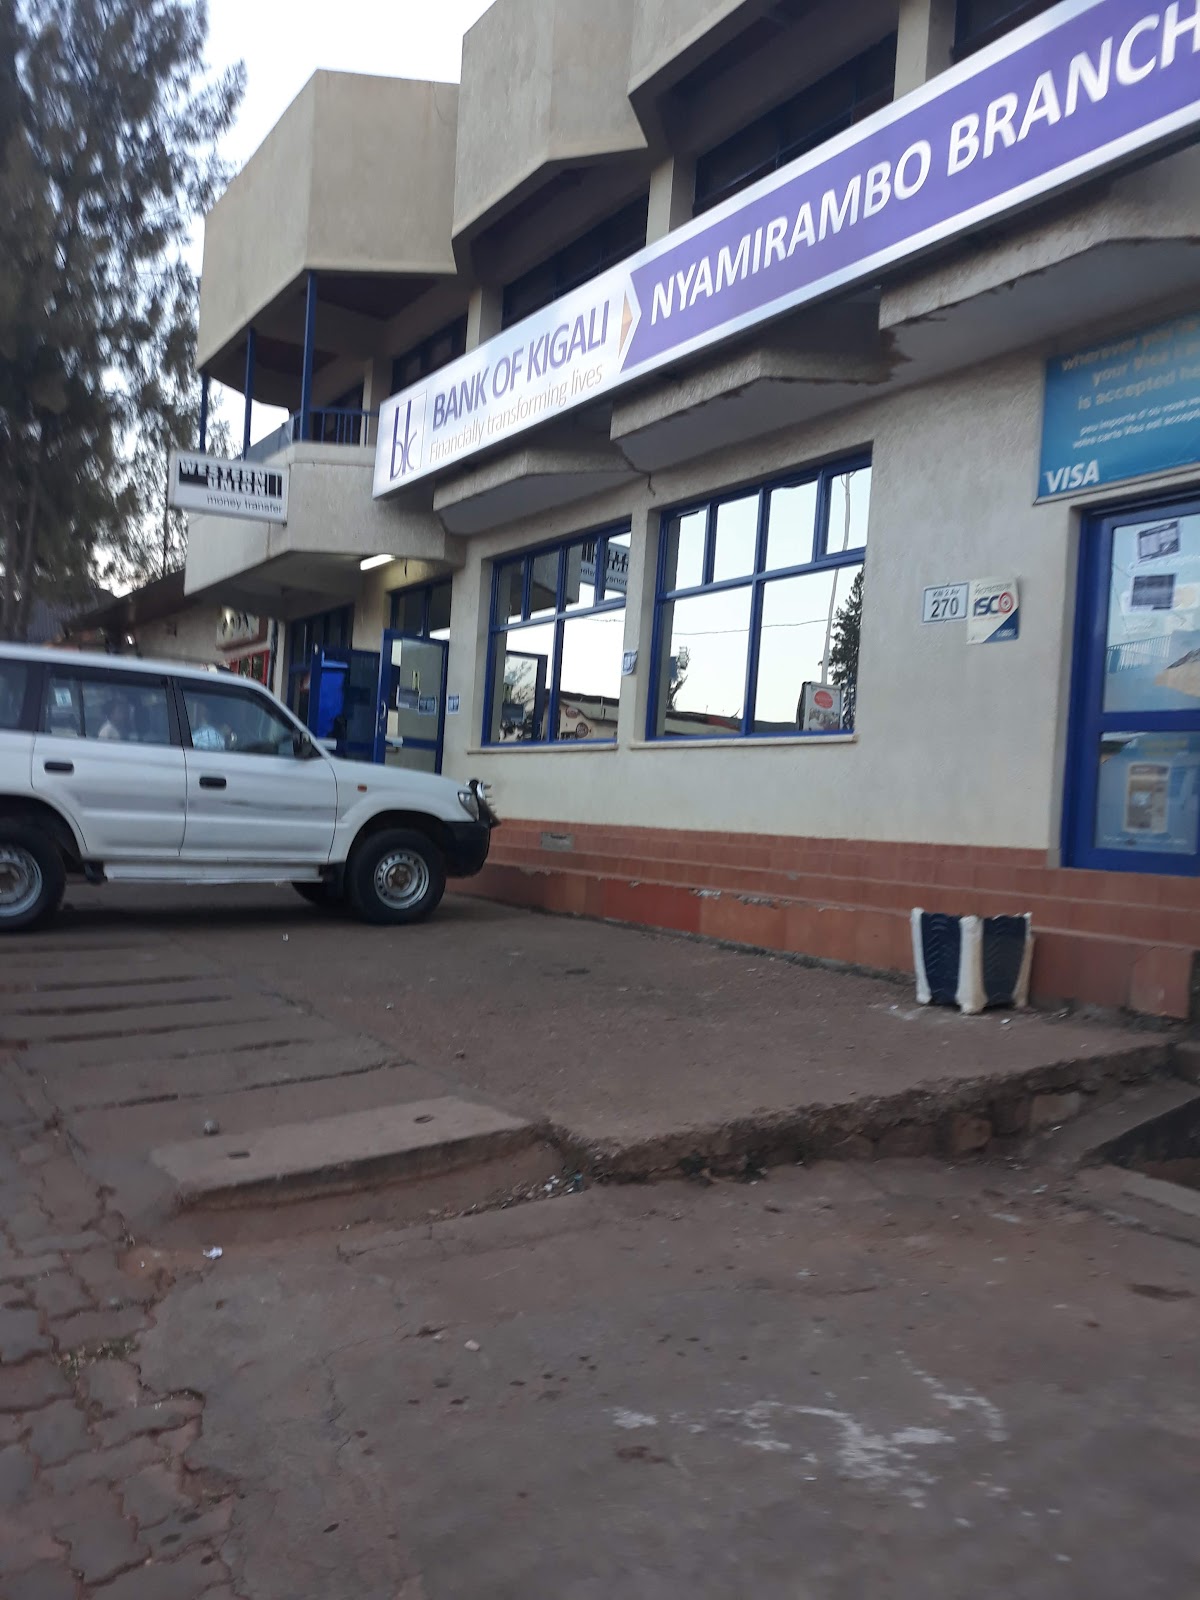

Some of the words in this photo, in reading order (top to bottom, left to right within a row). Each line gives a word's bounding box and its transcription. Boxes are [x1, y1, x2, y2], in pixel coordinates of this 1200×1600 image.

[650, 139, 932, 325] NYAMIRAMBO
[946, 0, 1200, 177] BRANCH
[432, 364, 490, 432] BANK
[492, 344, 524, 398] OF
[526, 300, 610, 383] KIGALI
[1096, 370, 1176, 406] accepted
[429, 414, 487, 463] Financially
[487, 381, 569, 435] transforming
[570, 364, 604, 396] lives
[179, 460, 266, 483] WESTERN
[207, 477, 266, 497] UNION
[1045, 459, 1100, 494] VISA
[206, 495, 241, 511] money
[244, 499, 283, 514] transfer
[930, 597, 960, 619] 270
